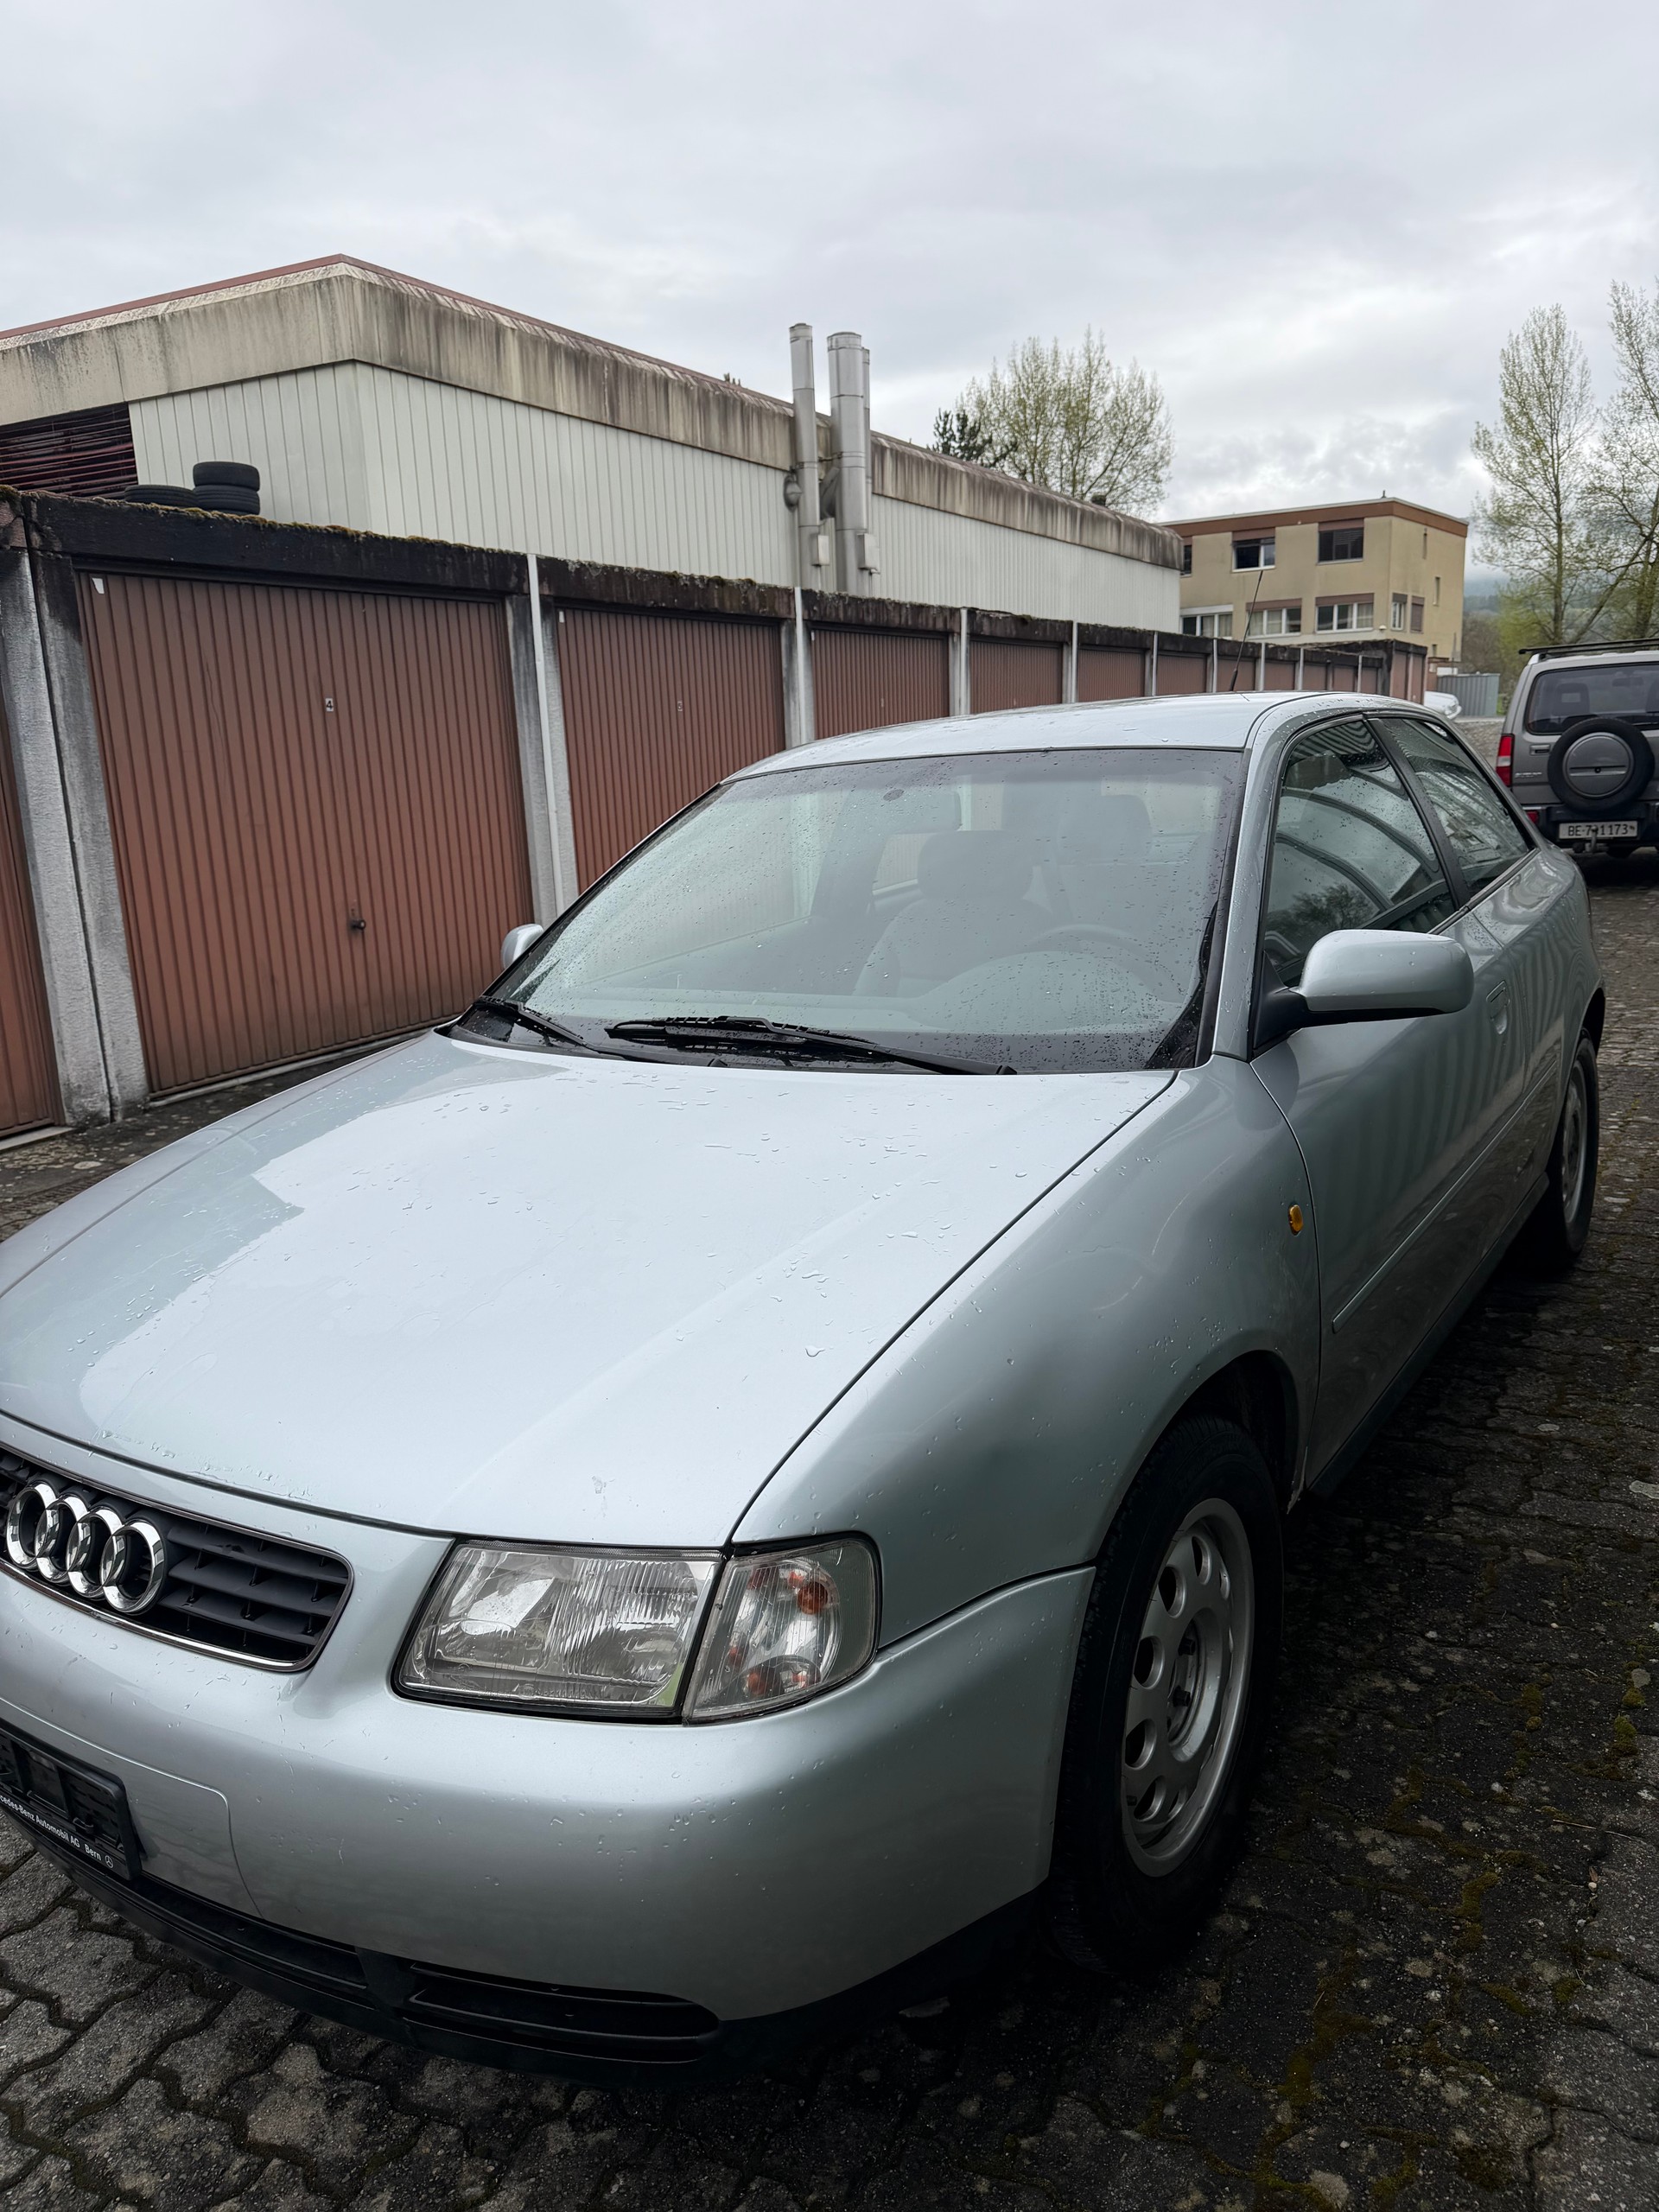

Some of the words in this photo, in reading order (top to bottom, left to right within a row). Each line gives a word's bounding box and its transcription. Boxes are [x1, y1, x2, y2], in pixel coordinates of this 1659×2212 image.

[35, 1815, 69, 1841] Automobil
[70, 1835, 80, 1847] AG
[84, 1843, 102, 1861] Bern
